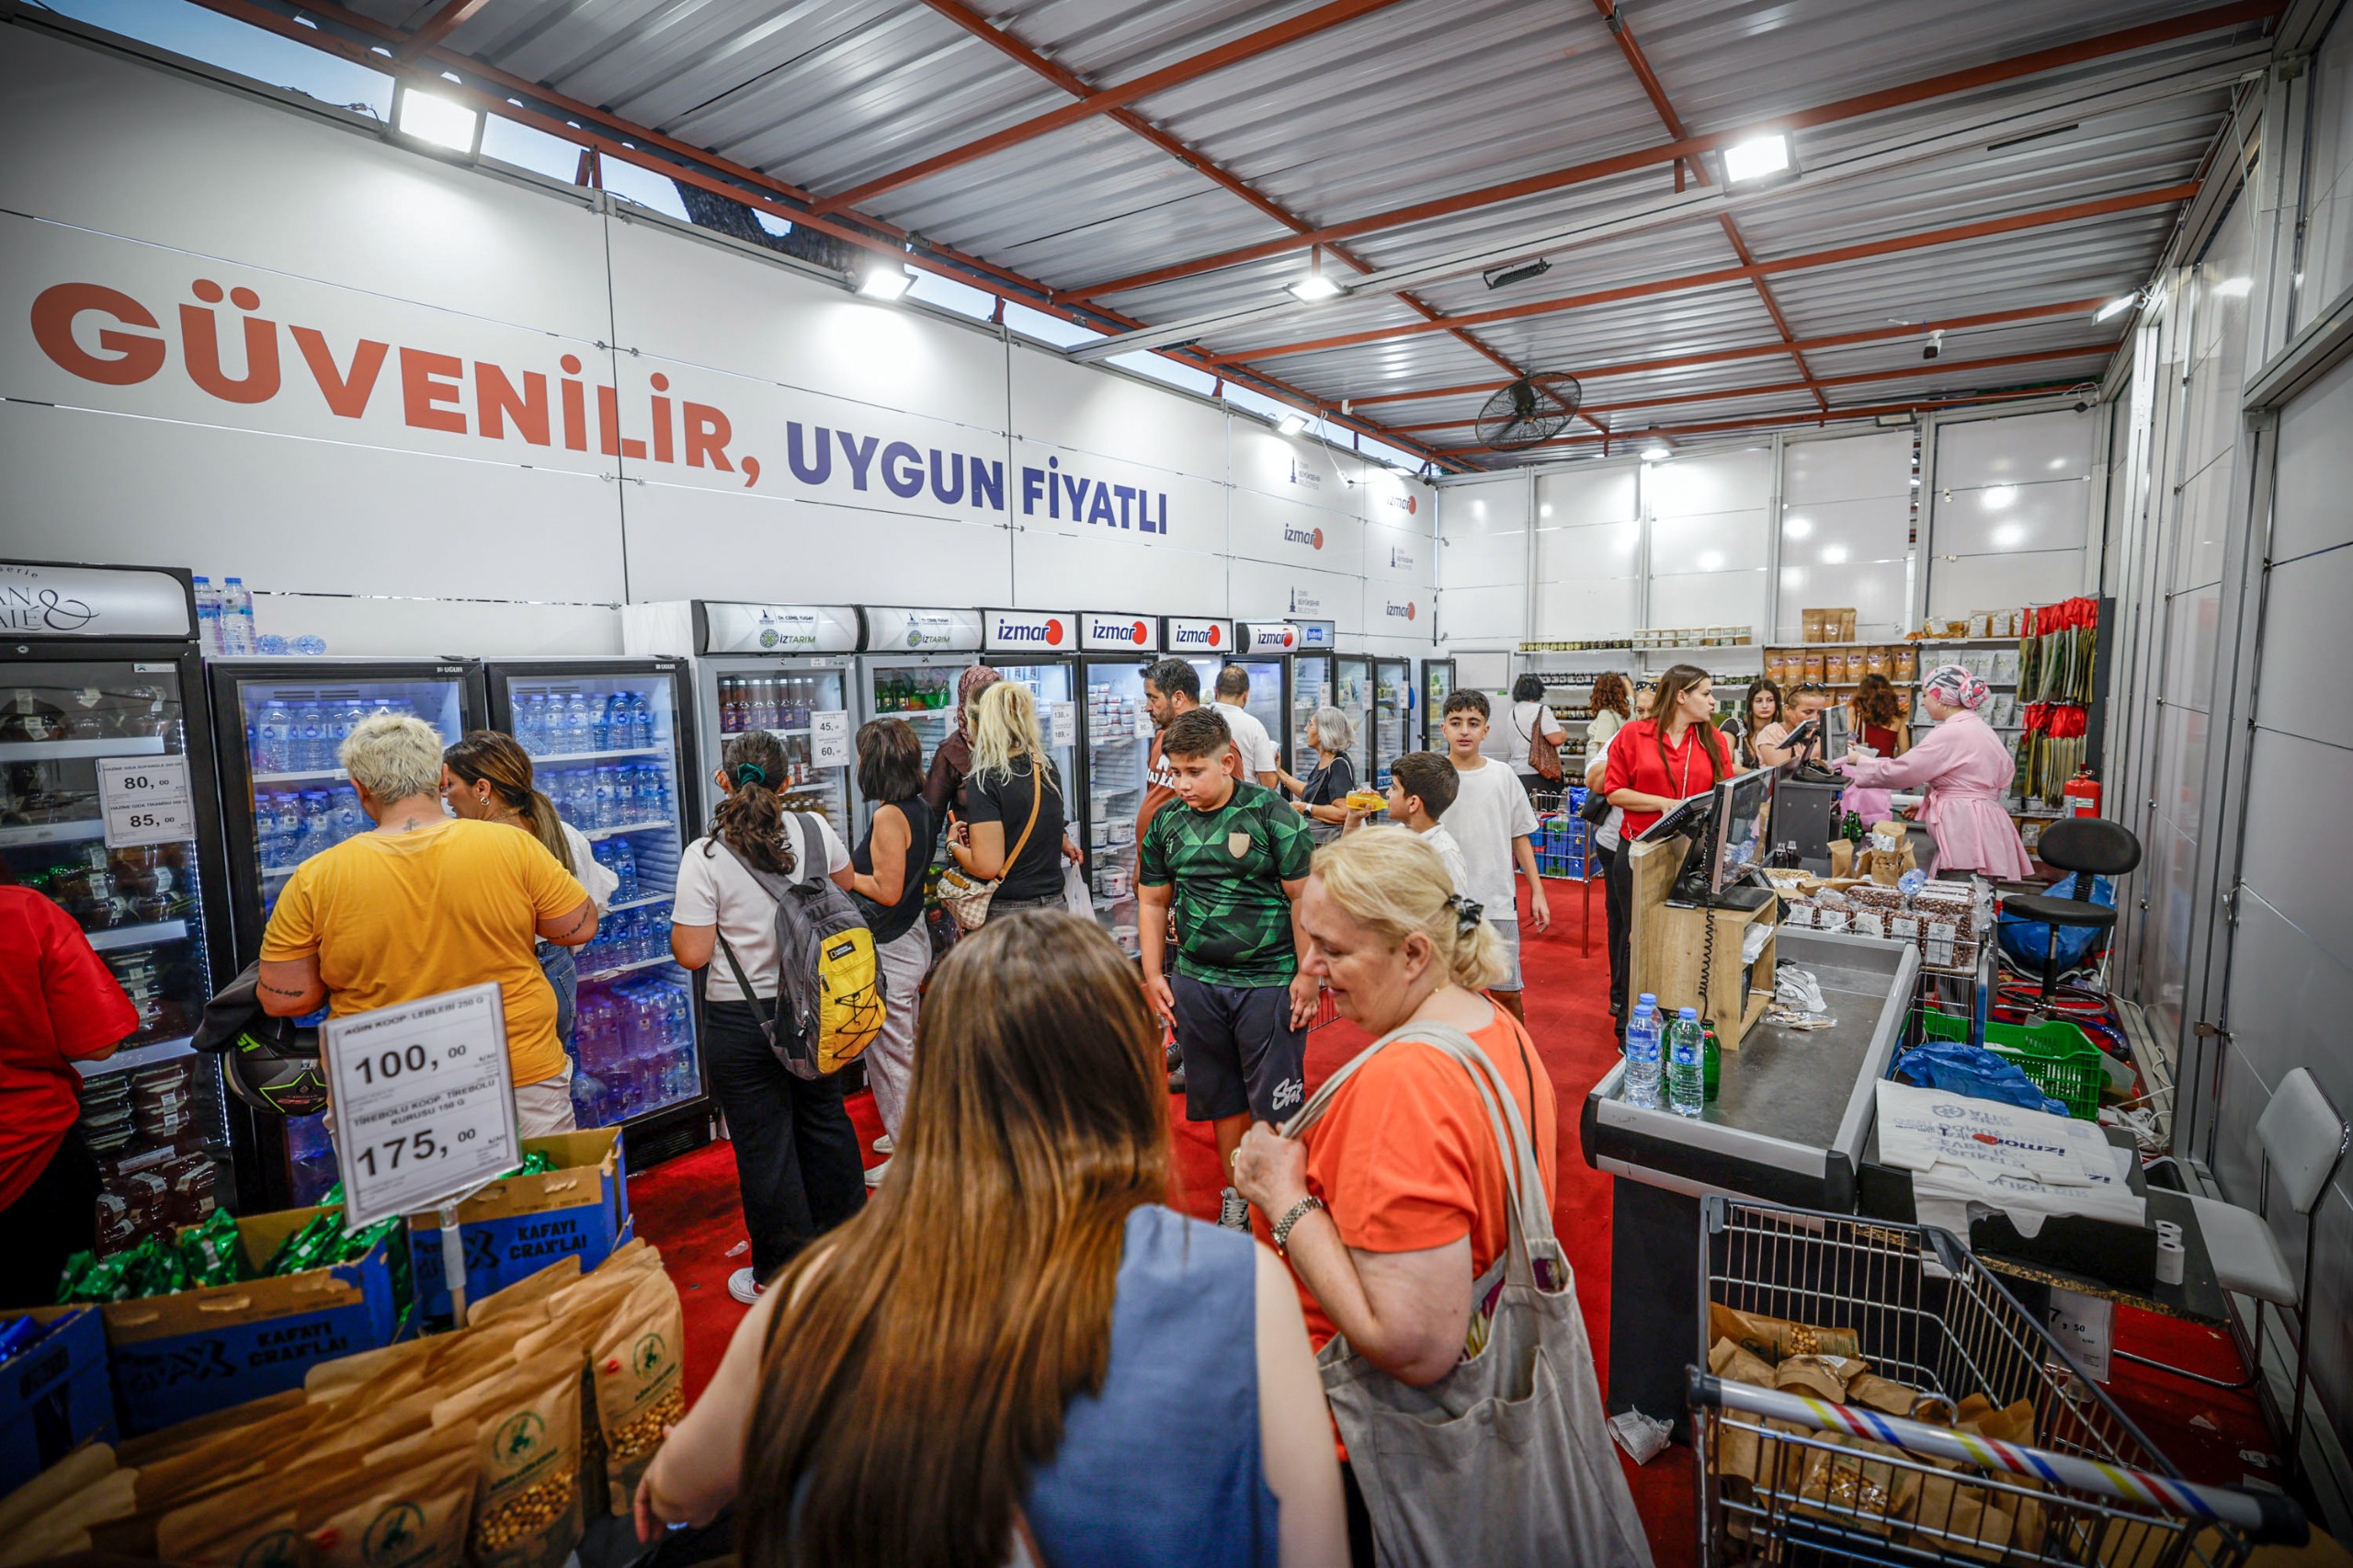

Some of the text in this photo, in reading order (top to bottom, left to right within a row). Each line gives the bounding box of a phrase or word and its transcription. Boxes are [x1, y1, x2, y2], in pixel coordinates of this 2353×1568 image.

[30, 278, 1167, 535] GÜVENİLİR, UYGUN FİYATLI
[1283, 522, 1315, 545] izmar
[1386, 600, 1409, 618] izmar
[779, 633, 816, 644] İZTARIM
[922, 634, 950, 644] İZTARIM
[997, 619, 1049, 641] izmar
[1093, 619, 1135, 640] izmar
[1176, 624, 1211, 643] izmar
[1257, 629, 1286, 644] izmar
[820, 722, 834, 732] 45,
[821, 746, 835, 756] 60,
[124, 776, 154, 790] 80,
[130, 813, 160, 827] 85,
[411, 1003, 455, 1019] LEBLEBİ
[458, 998, 474, 1009] 250
[355, 1044, 467, 1085] 100, 00
[354, 1105, 409, 1127] TİREBOLU
[447, 1079, 496, 1100] TİREBOLU
[390, 1108, 436, 1127] KURUSU
[357, 1129, 448, 1177] 175,
[457, 1128, 476, 1143] 00
[517, 1219, 576, 1242] KAFAYI
[256, 1321, 333, 1348] KAFAYI
[2074, 1324, 2086, 1333] 50
